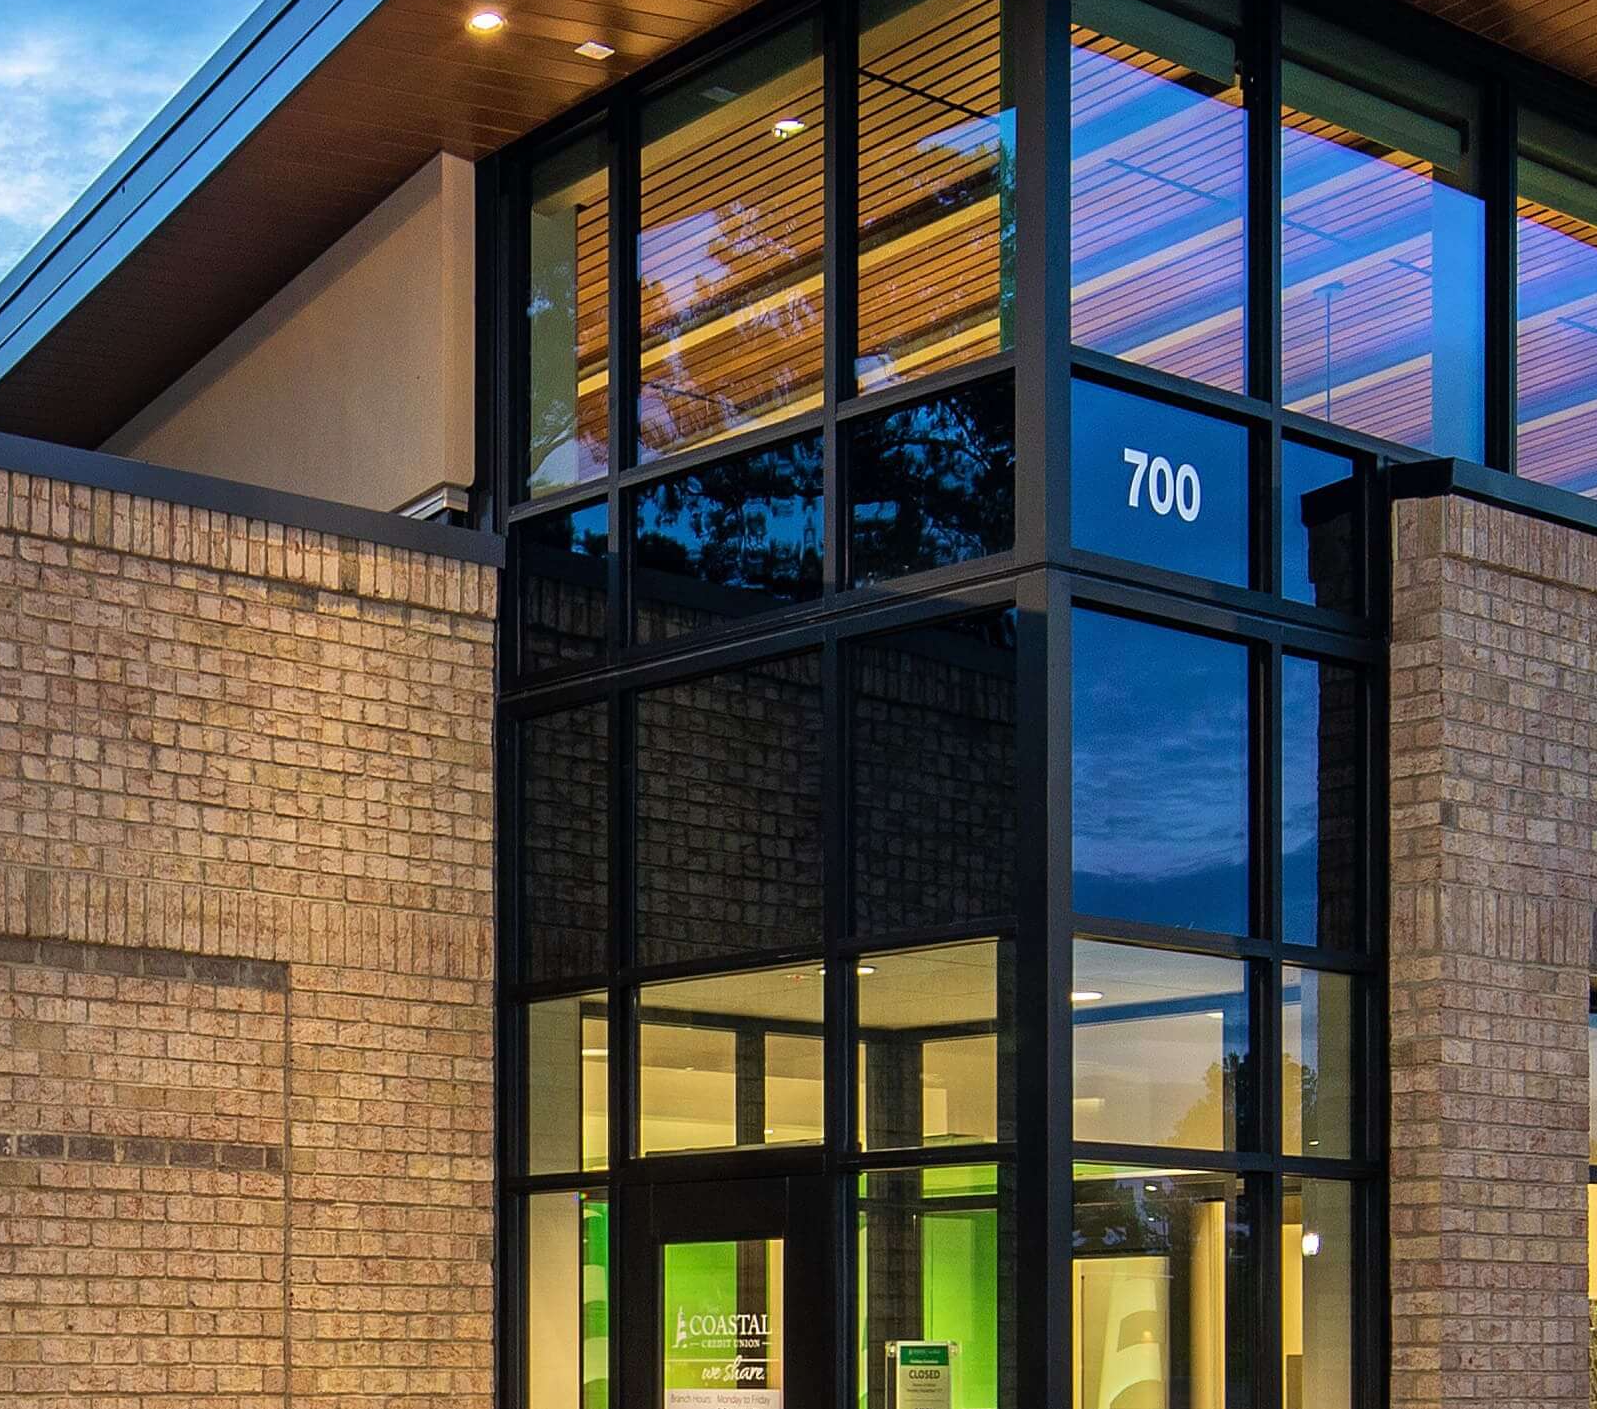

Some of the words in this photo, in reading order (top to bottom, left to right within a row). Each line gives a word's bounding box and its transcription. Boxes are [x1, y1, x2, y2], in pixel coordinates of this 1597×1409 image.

[1124, 447, 1202, 522] 700
[689, 1314, 772, 1336] COASTAL
[733, 1338, 761, 1348] UNION
[701, 1367, 722, 1380] we
[908, 1369, 941, 1380] CLOSED
[717, 1394, 742, 1405] Monday
[743, 1395, 750, 1404] to
[751, 1395, 771, 1407] Friday
